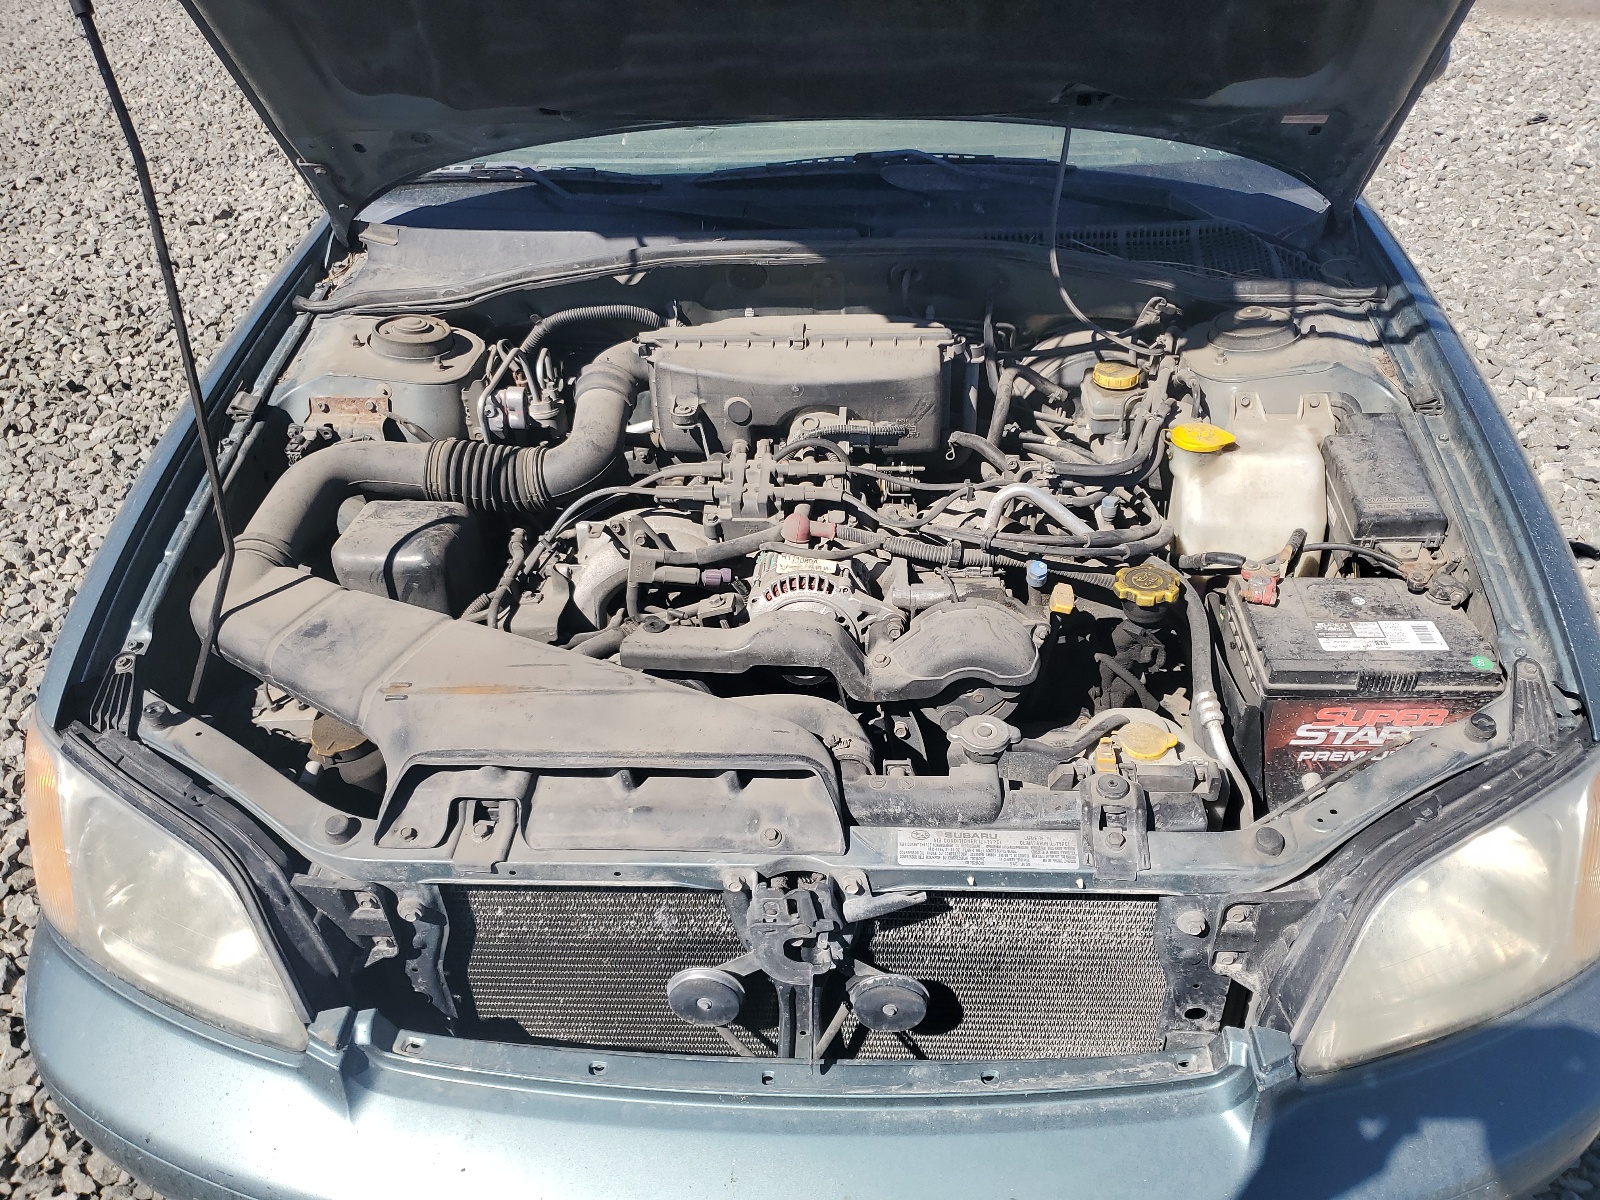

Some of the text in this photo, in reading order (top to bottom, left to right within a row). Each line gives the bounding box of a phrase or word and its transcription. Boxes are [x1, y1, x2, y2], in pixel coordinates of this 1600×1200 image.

[1311, 707, 1449, 727] SUPER
[1296, 750, 1397, 762] PREMU
[944, 832, 998, 840] SUBARU
